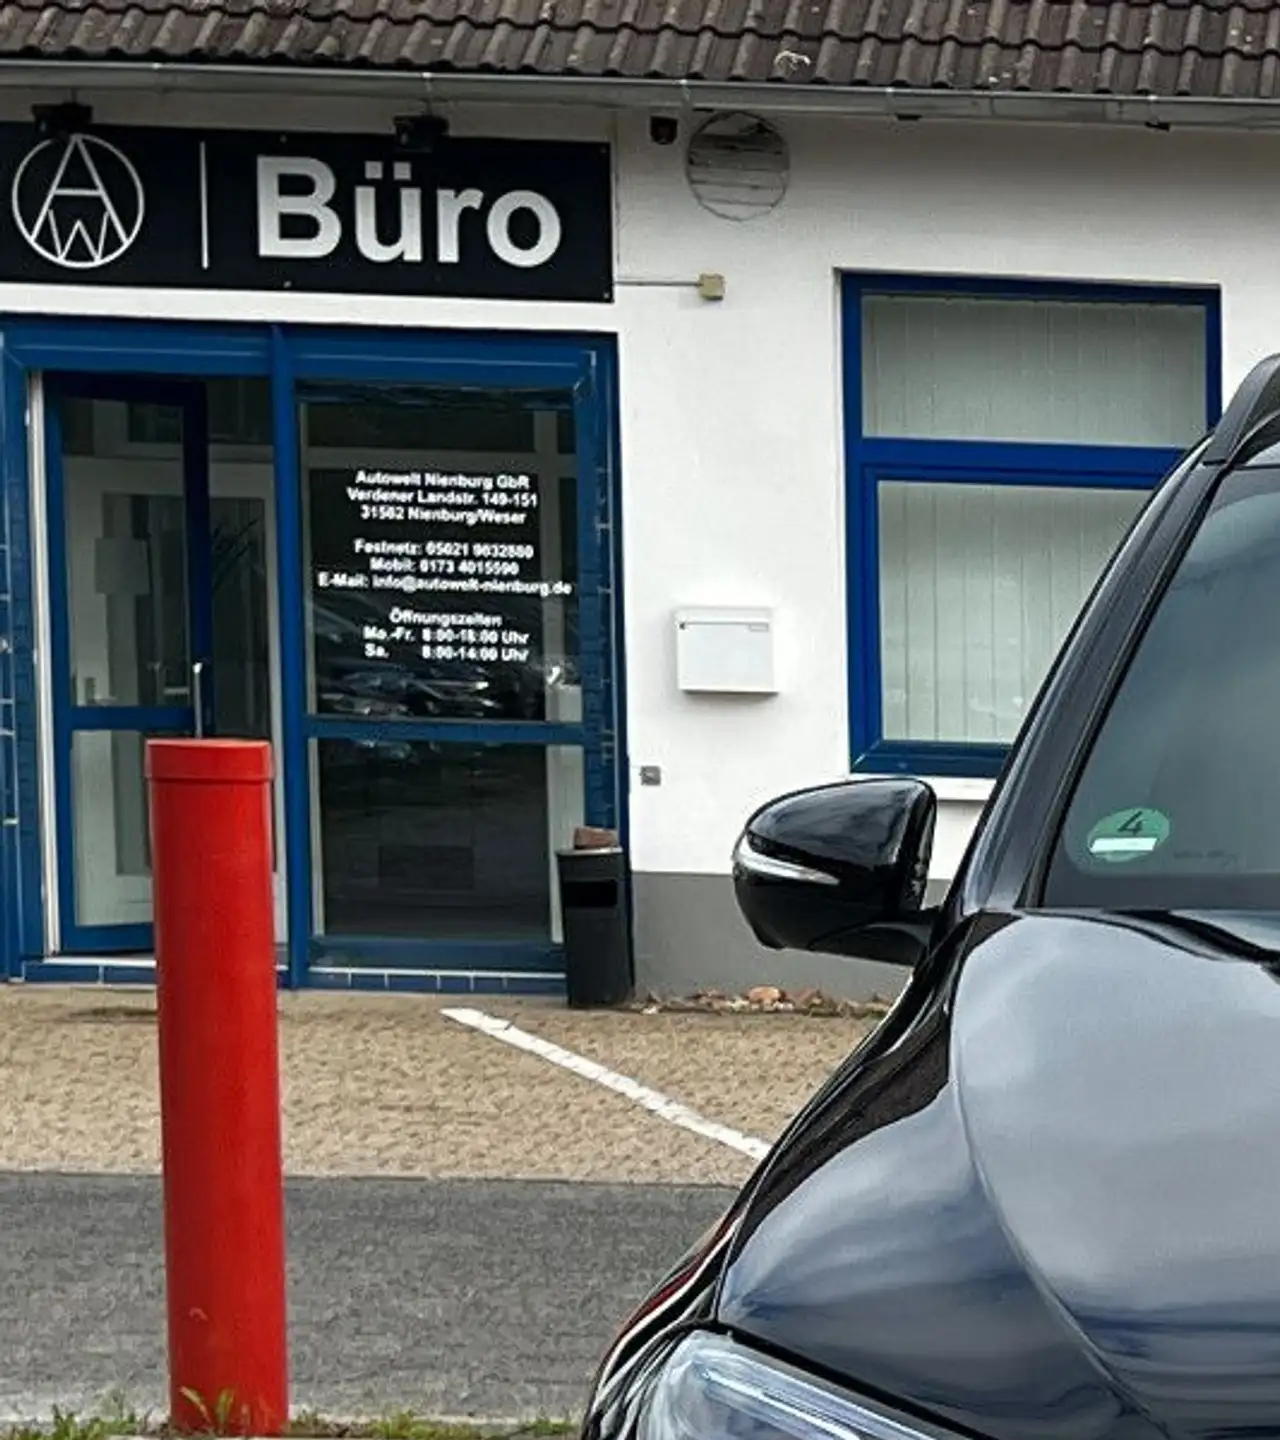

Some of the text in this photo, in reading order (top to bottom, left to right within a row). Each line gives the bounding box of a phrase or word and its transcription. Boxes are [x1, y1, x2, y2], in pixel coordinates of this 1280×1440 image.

[256, 154, 562, 268] Büro
[355, 470, 531, 490] Autowelt Nienburg GbR
[346, 486, 538, 508] Verdener Landstr. 149-151
[408, 506, 527, 526] Nienburg/Weser
[353, 538, 422, 555] Festnetz:
[369, 557, 416, 573] Mobil:
[419, 559, 455, 574] 0173
[317, 571, 369, 588] E-Mail:
[388, 606, 503, 628] Öffnungszeiten
[501, 630, 531, 646] Uhr
[363, 643, 391, 659] Sa.
[501, 647, 531, 663] Uhr
[1116, 810, 1144, 836] 4
